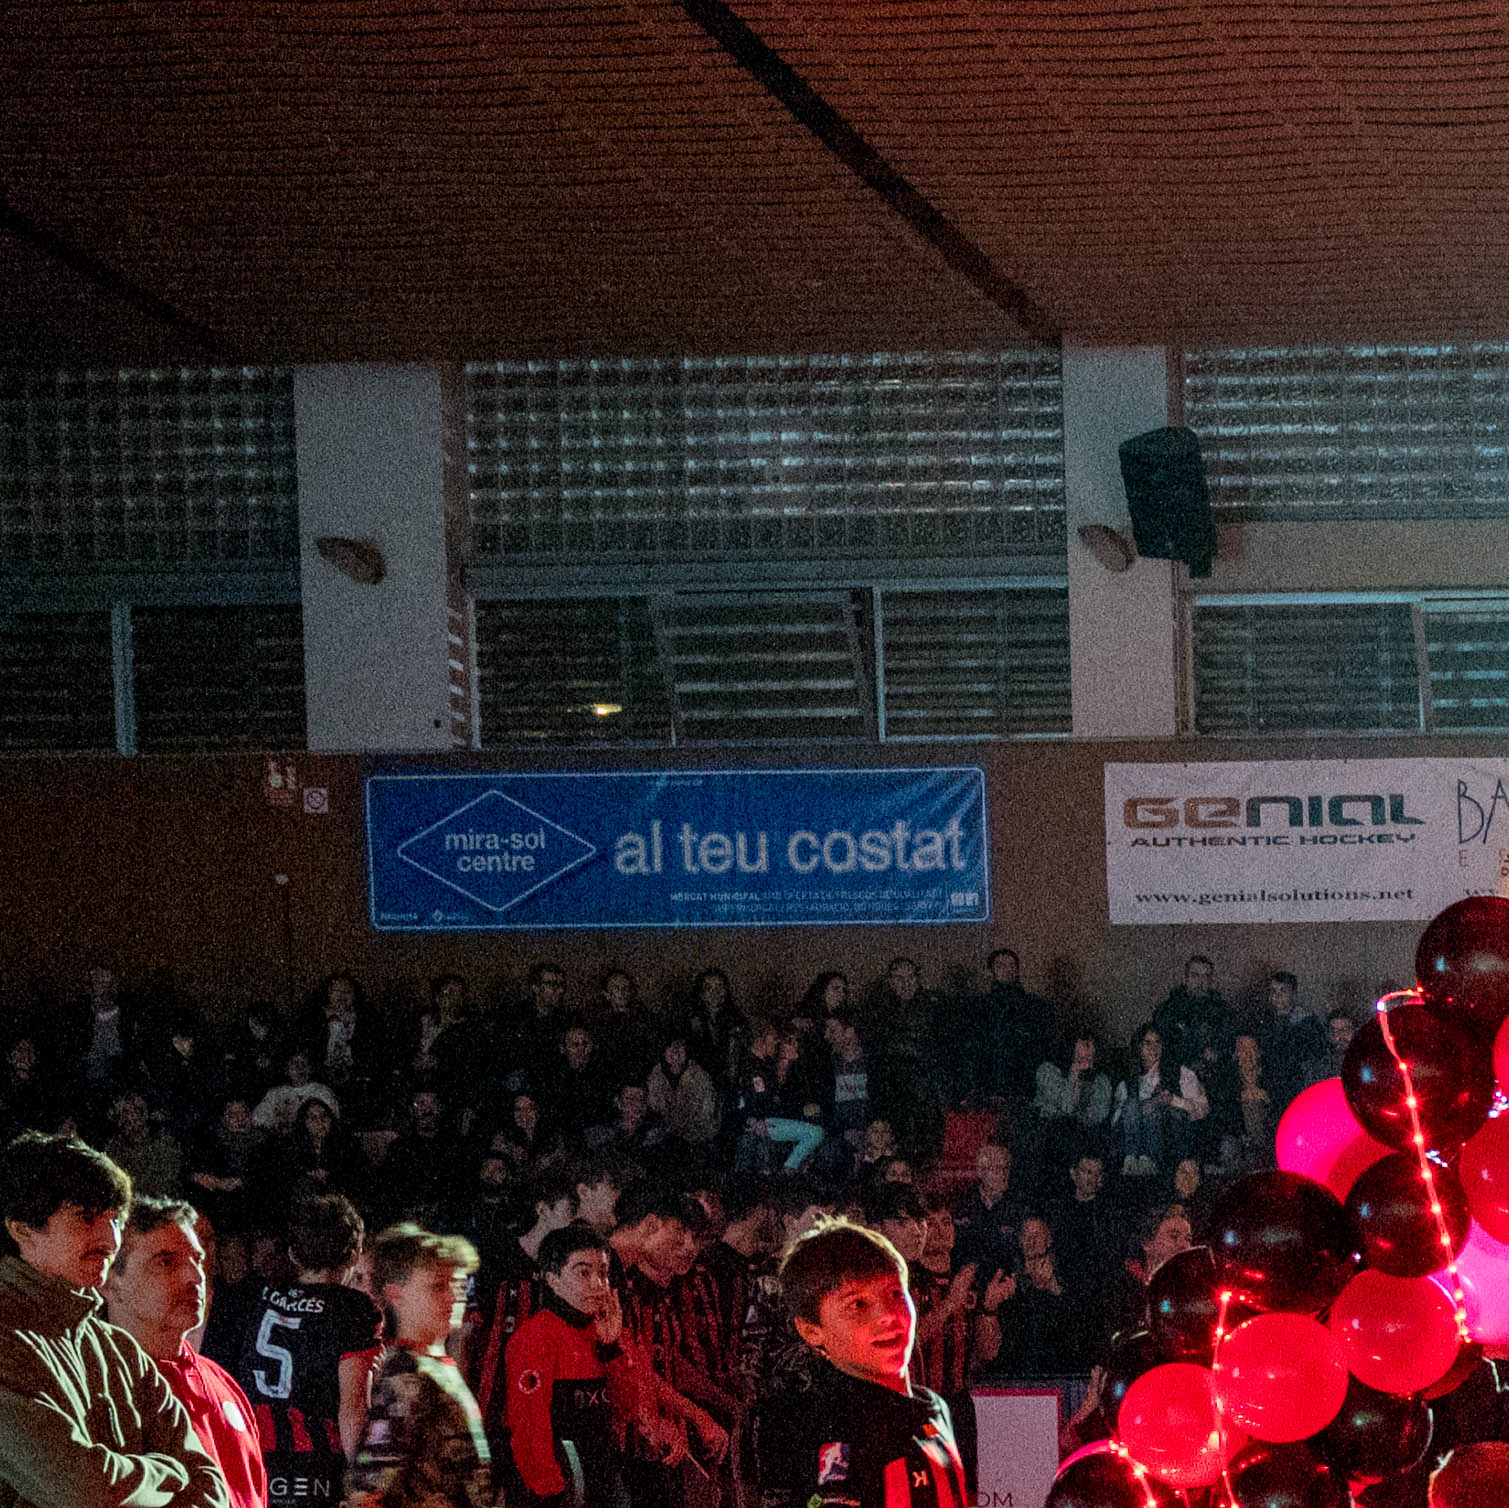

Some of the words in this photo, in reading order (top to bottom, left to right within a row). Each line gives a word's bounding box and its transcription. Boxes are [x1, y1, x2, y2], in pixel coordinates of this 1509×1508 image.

[445, 827, 546, 850] mira-sol
[614, 819, 663, 876] al
[677, 822, 770, 875] teu
[786, 818, 967, 875] costat
[1130, 834, 1291, 849] AUTHENTIC
[1299, 832, 1417, 846] HOCKEY
[457, 851, 536, 873] centre
[1134, 888, 1414, 905] www.genialsolutions.net
[252, 1307, 302, 1400] 5
[269, 1476, 332, 1498] GEN
[976, 1490, 1014, 1508] OM
